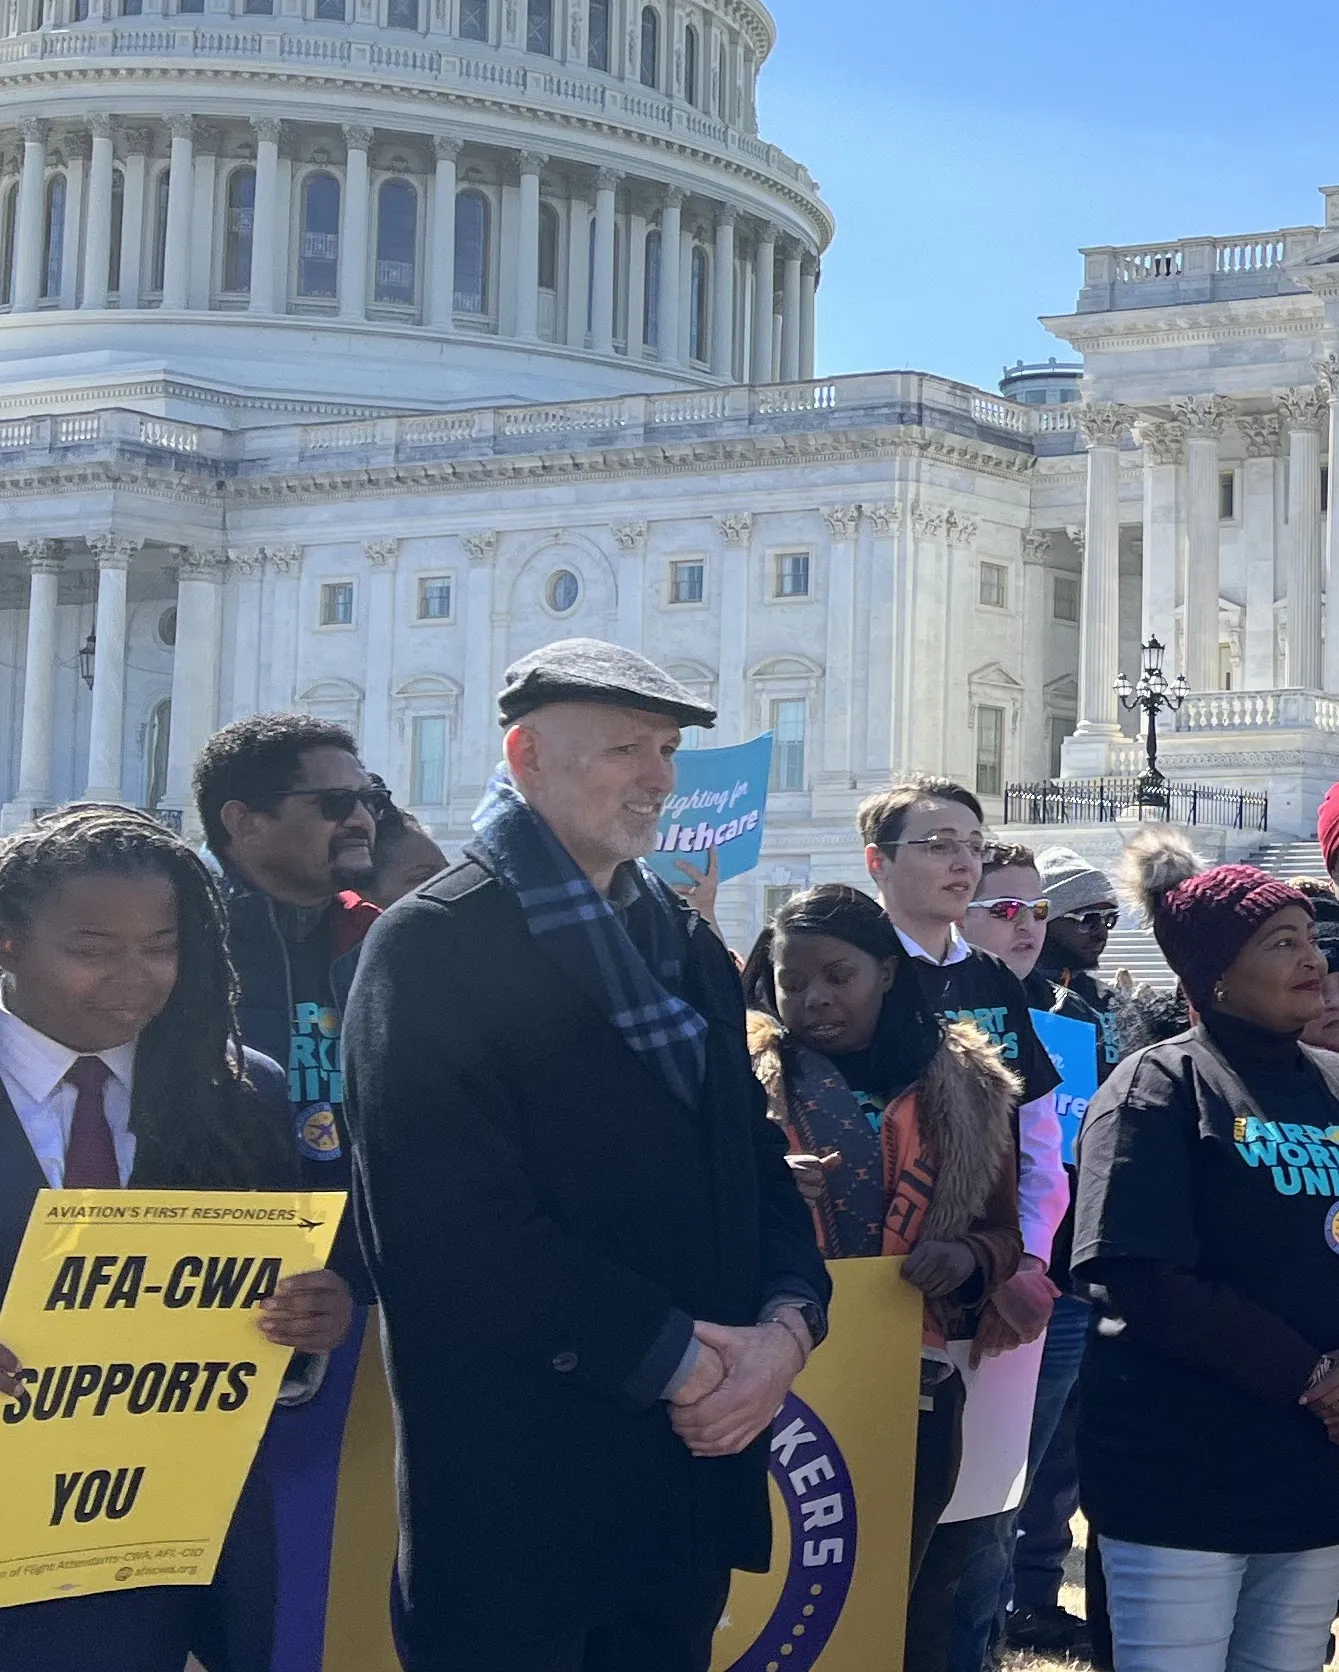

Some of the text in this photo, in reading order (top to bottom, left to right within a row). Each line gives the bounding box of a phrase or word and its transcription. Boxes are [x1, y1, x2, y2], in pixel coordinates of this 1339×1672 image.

[728, 780, 749, 808] for
[655, 810, 758, 853] lthcare
[47, 1206, 297, 1220] AVIATION'S FIRST RESPONDERS
[44, 1255, 283, 1311] AFA-CWA
[2, 1361, 257, 1425] SUPPORTS
[49, 1466, 146, 1527] YOU
[770, 1404, 844, 1568] KERS
